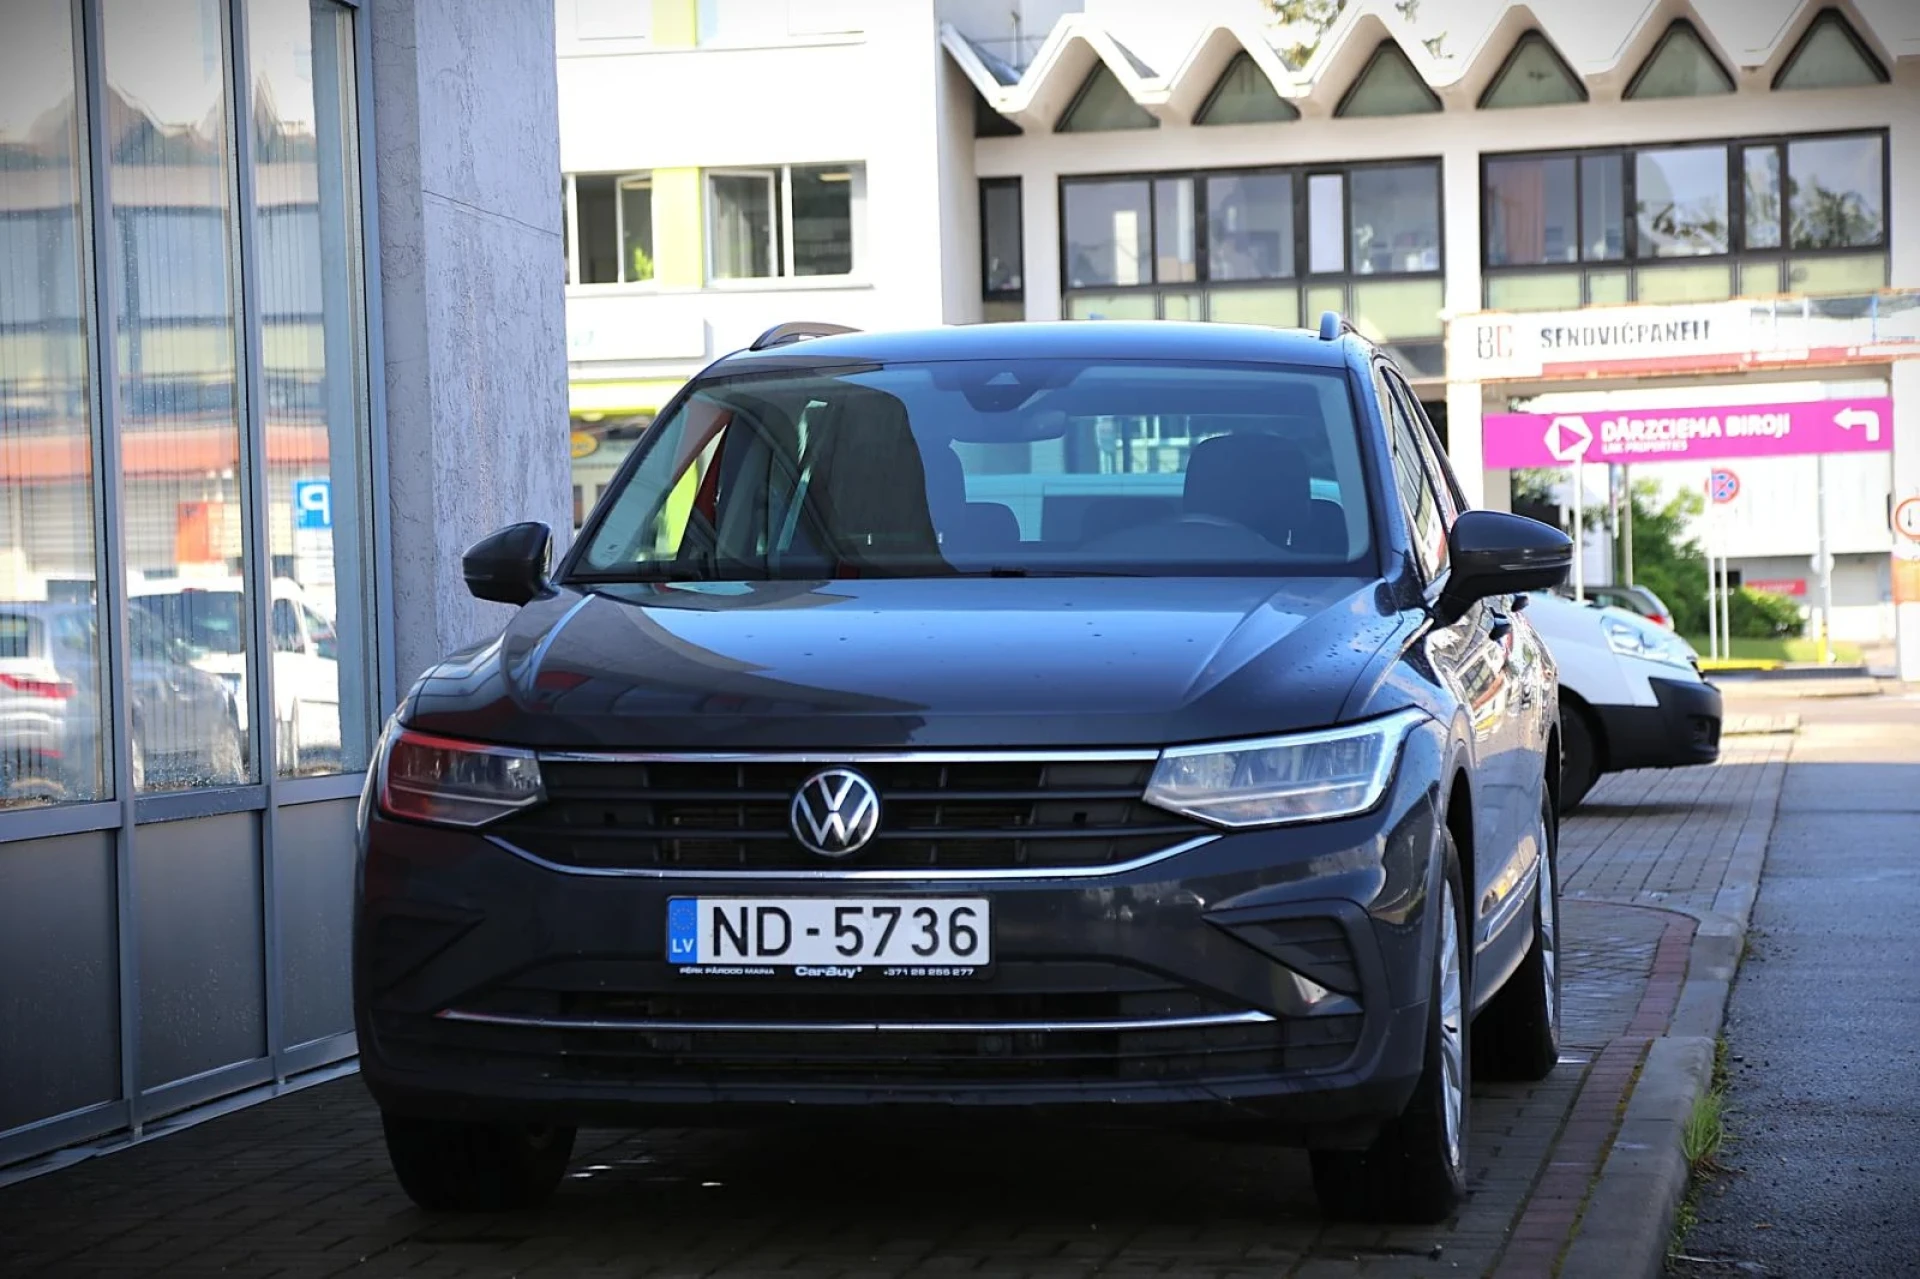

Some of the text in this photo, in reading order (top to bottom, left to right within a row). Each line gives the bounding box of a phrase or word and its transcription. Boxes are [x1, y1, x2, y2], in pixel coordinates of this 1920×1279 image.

[1725, 412, 1791, 438] BIROJI
[712, 906, 978, 957] ND-5736
[672, 938, 693, 953] LV
